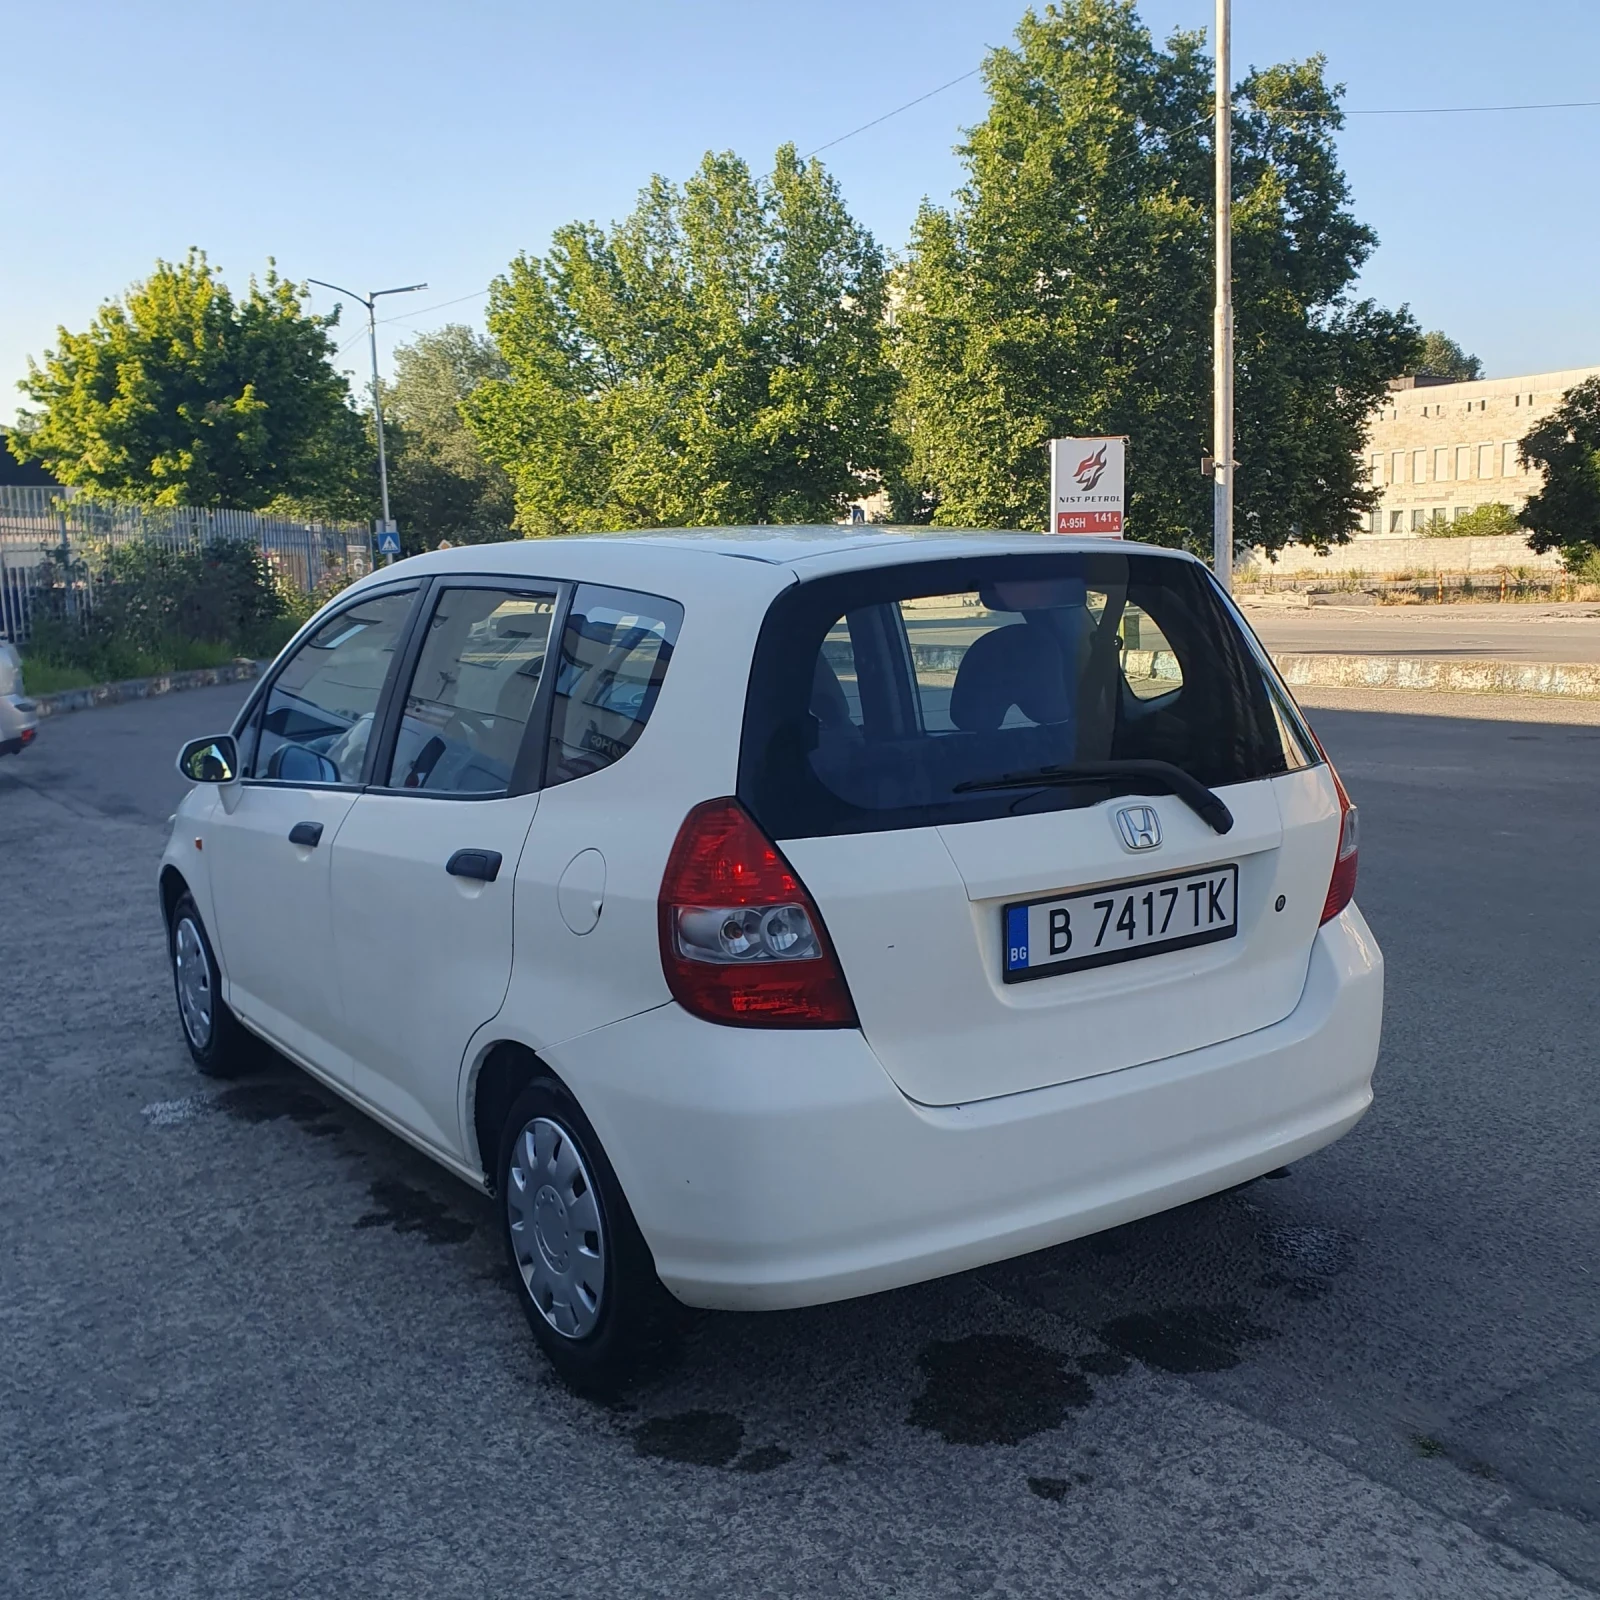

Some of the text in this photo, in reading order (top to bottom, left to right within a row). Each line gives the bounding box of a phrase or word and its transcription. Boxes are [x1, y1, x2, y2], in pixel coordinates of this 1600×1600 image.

[1049, 877, 1228, 955] B 7417 TK
[1010, 947, 1027, 961] BG
